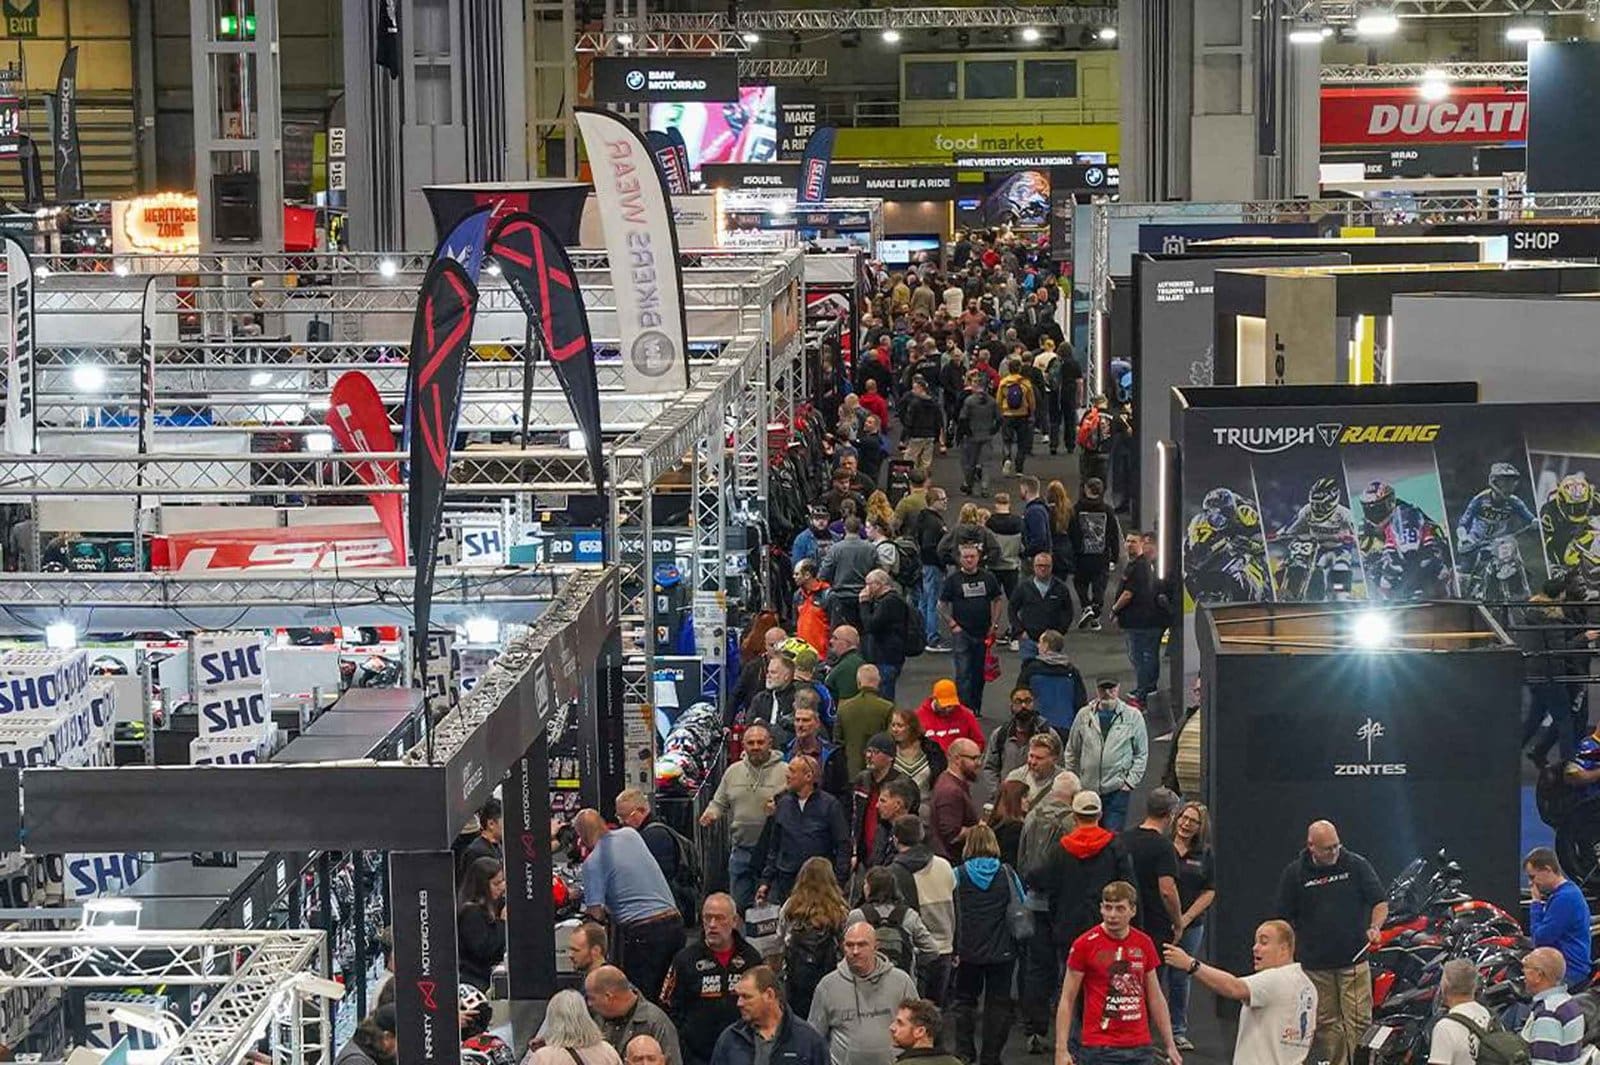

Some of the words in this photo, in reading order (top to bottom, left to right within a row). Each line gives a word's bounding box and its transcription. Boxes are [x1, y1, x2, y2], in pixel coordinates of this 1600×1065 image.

[9, 17, 34, 33] EXIT
[648, 71, 676, 79] BMW
[648, 81, 707, 90] MOTORRAD
[784, 111, 816, 123] MAKE
[1368, 101, 1527, 135] DUCATI
[935, 133, 978, 151] food
[981, 133, 1044, 150] market
[957, 156, 1073, 167] #NEVERSTOPCHALLENGING
[743, 175, 782, 185] #SOULFUEL
[866, 179, 896, 189] MAKE
[897, 178, 918, 188] LIFE
[918, 178, 926, 188] A
[926, 178, 950, 188] RIDE
[144, 208, 197, 223] HERITAGE
[156, 222, 185, 238] ZONE
[1513, 231, 1560, 250] SHOP
[1213, 427, 1314, 453] TRIUMPH
[1340, 424, 1441, 443] RACING
[1334, 764, 1407, 775] ZONTES
[418, 890, 430, 976] MOTORCYCLES
